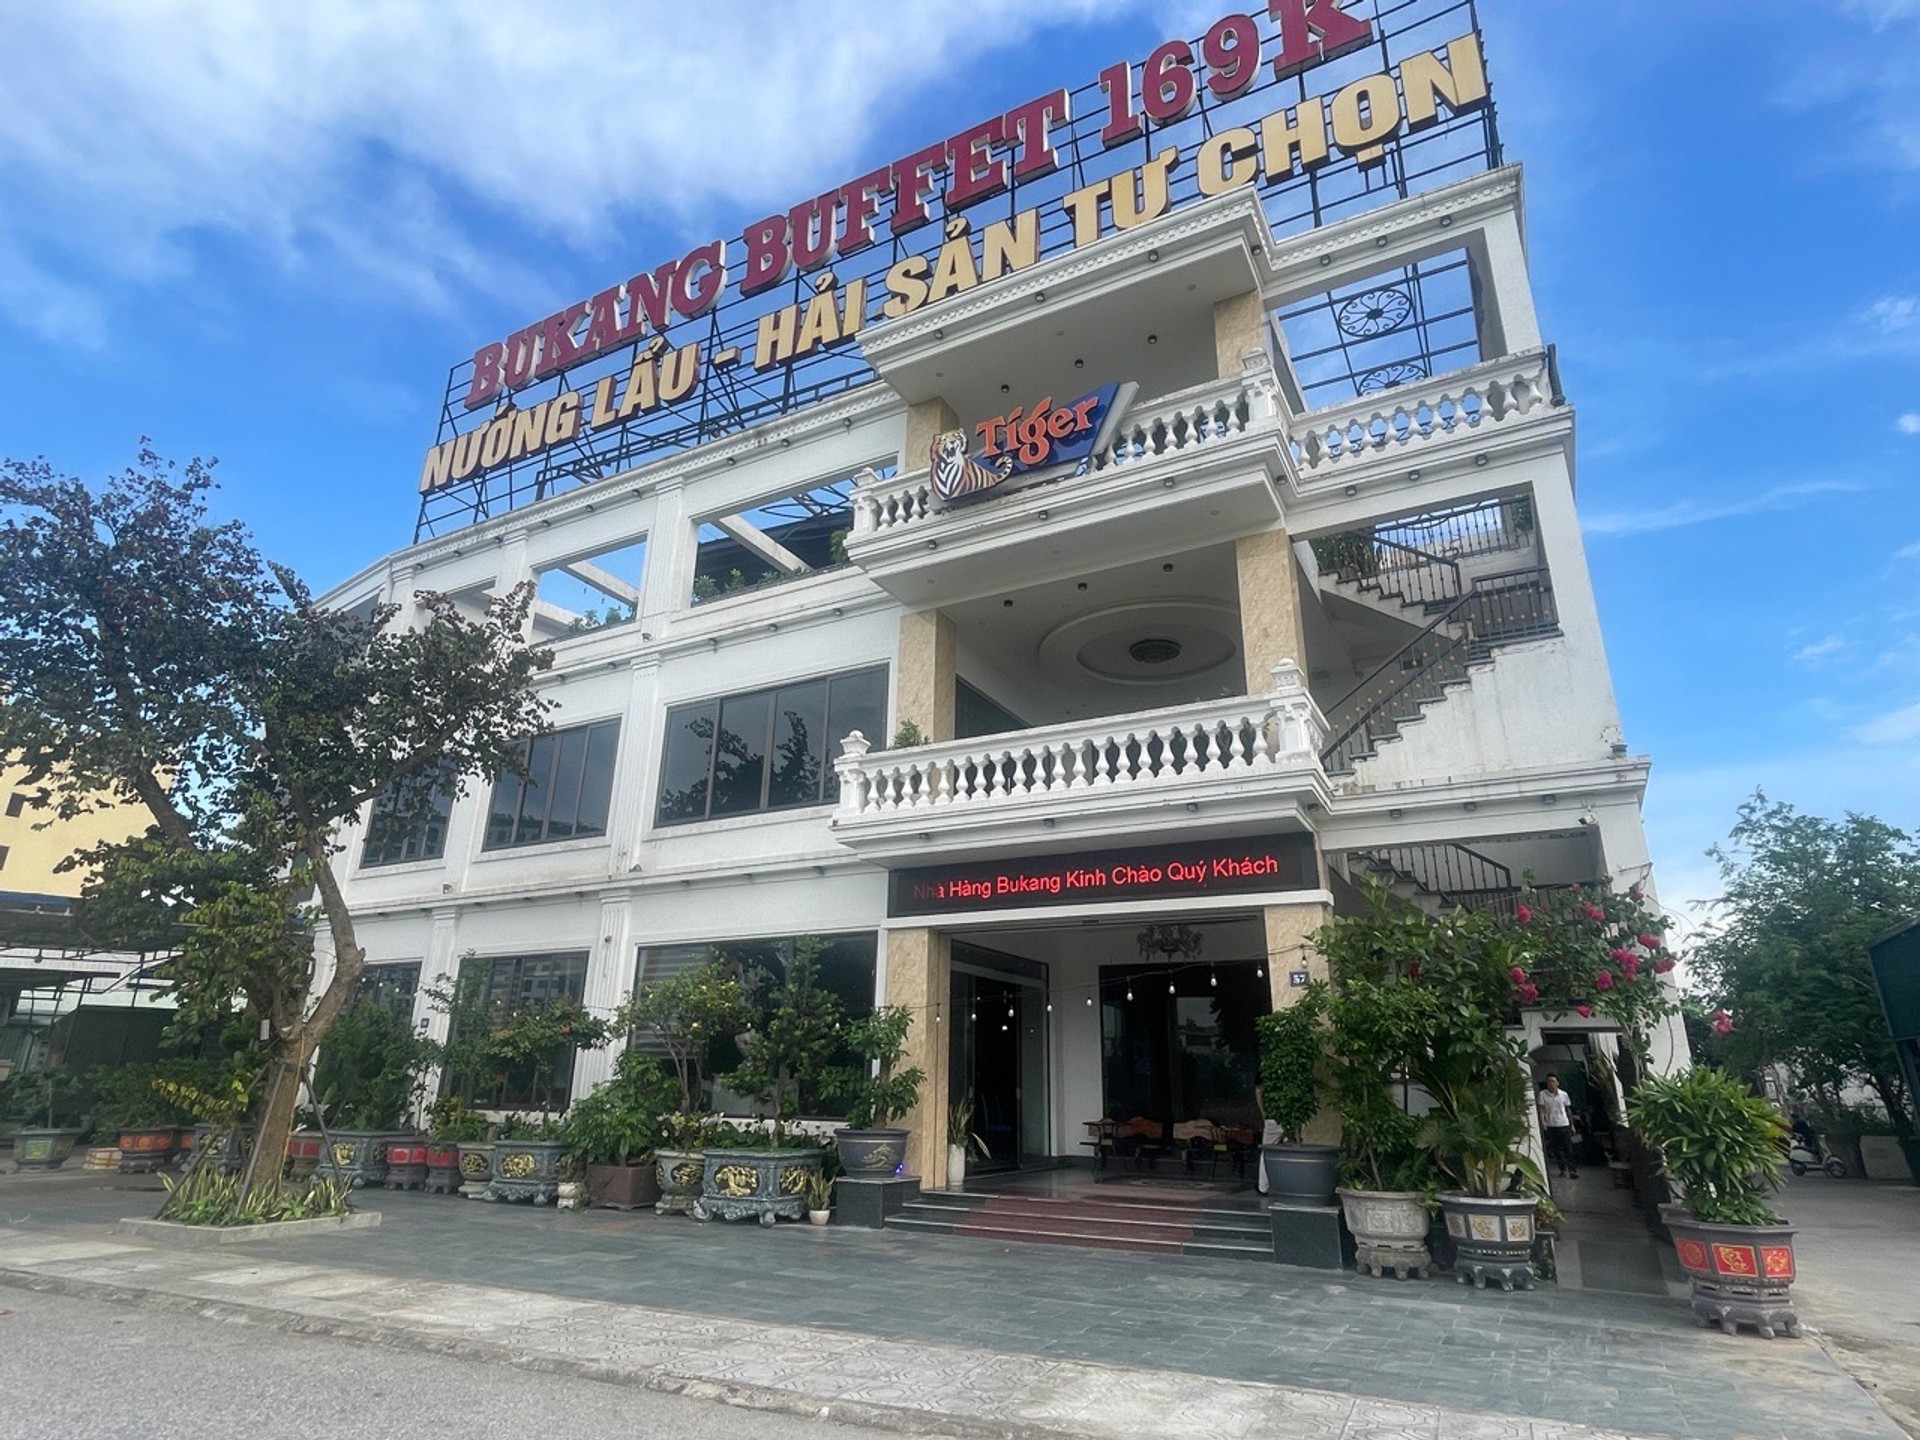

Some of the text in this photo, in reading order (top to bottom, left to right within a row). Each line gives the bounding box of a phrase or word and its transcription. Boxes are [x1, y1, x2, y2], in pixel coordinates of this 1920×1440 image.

[464, 0, 1374, 411] BUKANG BUFFET 169K
[419, 391, 583, 494] NƯỚNG
[713, 346, 741, 369] -
[753, 272, 868, 372] HẢI
[883, 217, 1040, 318] SẢN
[1197, 32, 1490, 198] CHỌN
[976, 396, 1099, 465] Tiger
[949, 880, 992, 899] Hàng
[997, 875, 1061, 894] Bukang
[1112, 865, 1162, 885] Chào
[1167, 860, 1207, 883] Quý
[1213, 855, 1278, 878] Khách
[1292, 974, 1306, 984] 57
